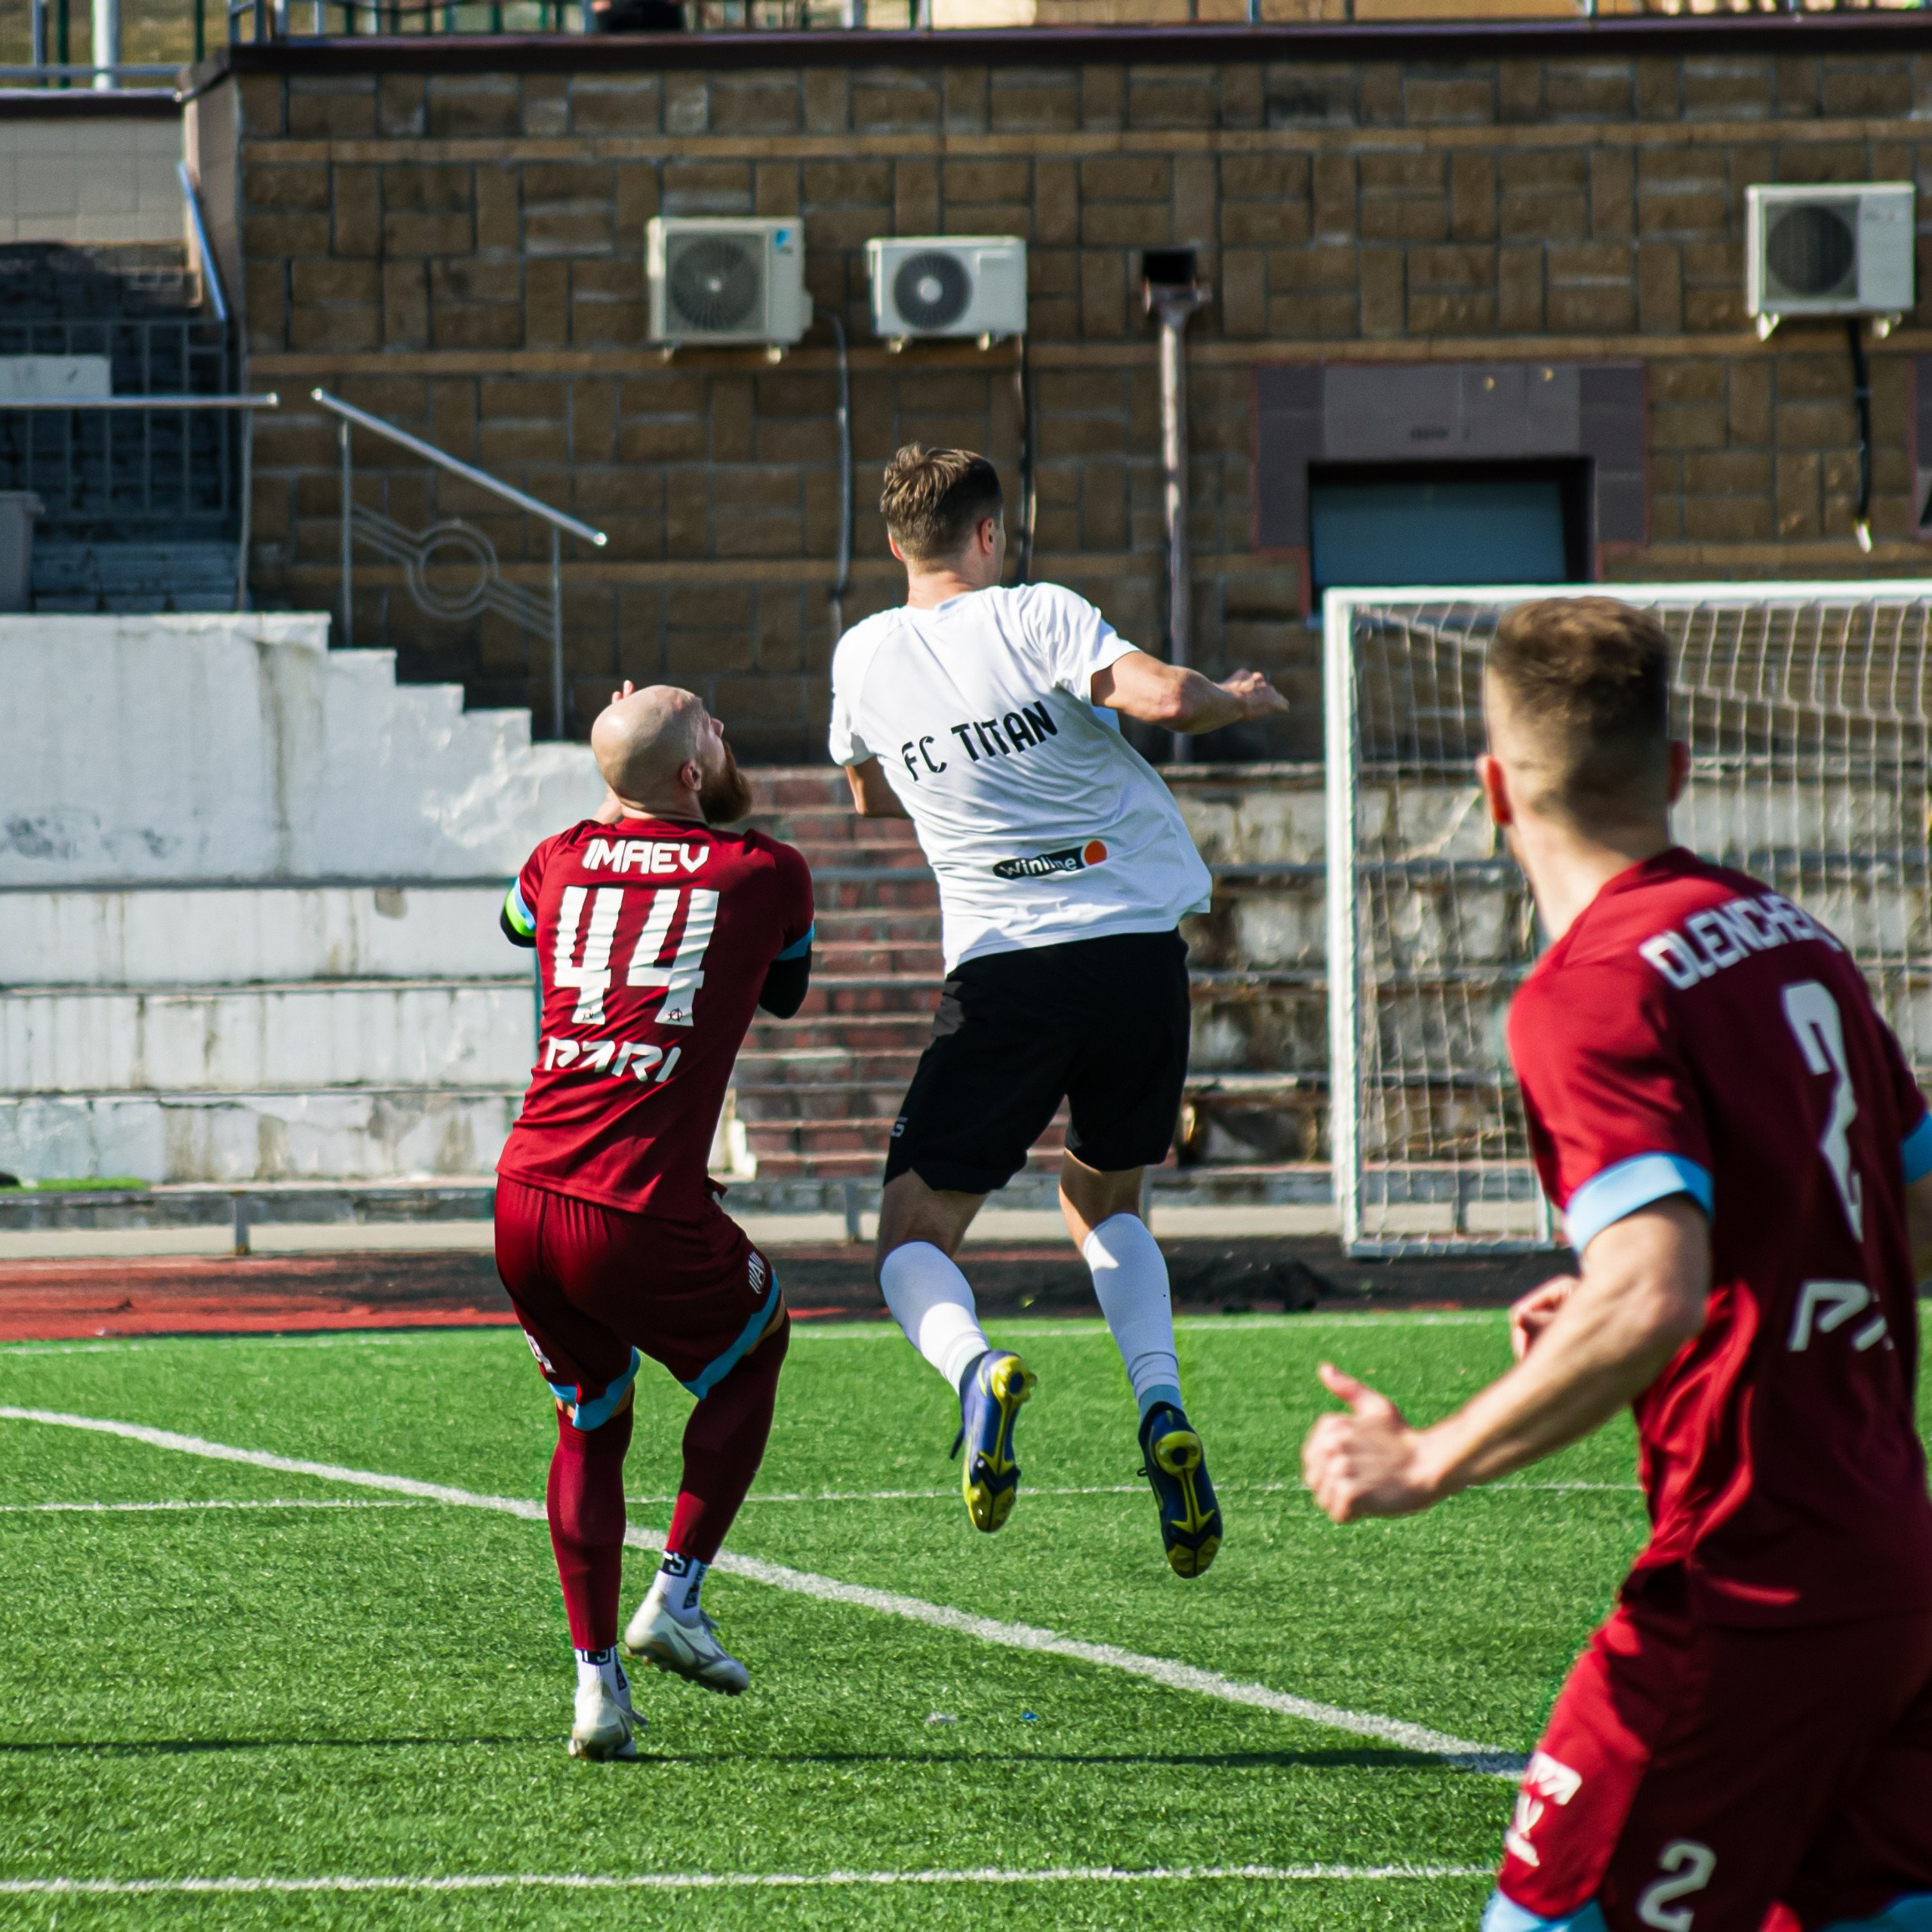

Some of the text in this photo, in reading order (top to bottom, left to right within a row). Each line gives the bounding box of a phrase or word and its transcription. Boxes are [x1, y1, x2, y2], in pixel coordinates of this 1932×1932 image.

[901, 700, 1058, 782] FC TITAN
[581, 838, 710, 875] IMAEV
[999, 857, 1078, 876] winline
[553, 886, 720, 1026] 44
[543, 1036, 681, 1083] PARI
[1782, 980, 1864, 1243] 2
[1637, 1837, 1718, 1932] 2
